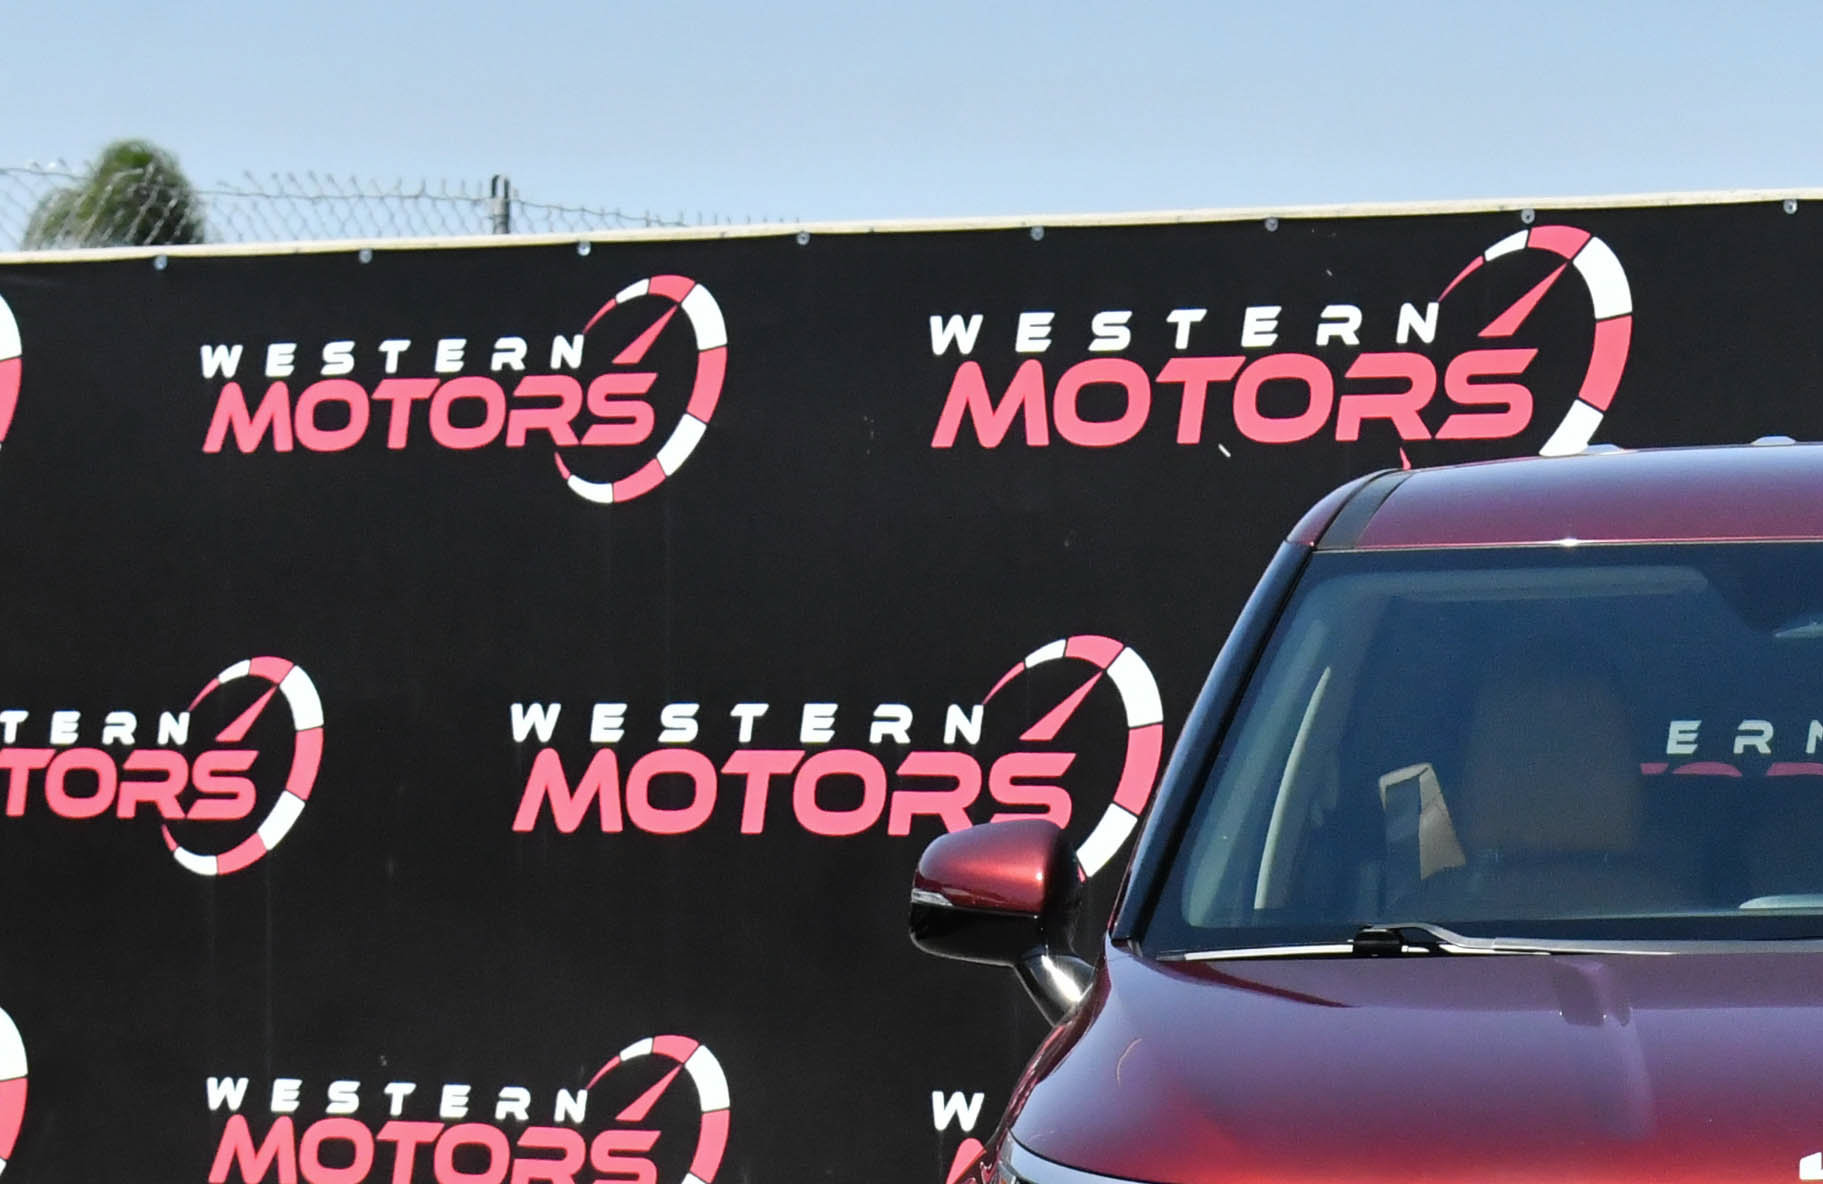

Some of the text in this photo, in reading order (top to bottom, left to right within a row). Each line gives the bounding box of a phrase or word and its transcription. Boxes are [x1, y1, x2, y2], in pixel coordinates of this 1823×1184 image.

[930, 303, 1439, 355] WESTERN
[201, 335, 584, 377] WESTERN
[203, 373, 657, 453] MOTORS
[931, 348, 1538, 448] MOTORS
[511, 703, 983, 744] WESTERN
[512, 748, 1076, 836] MOTORS
[207, 1077, 588, 1123] WESTERN
